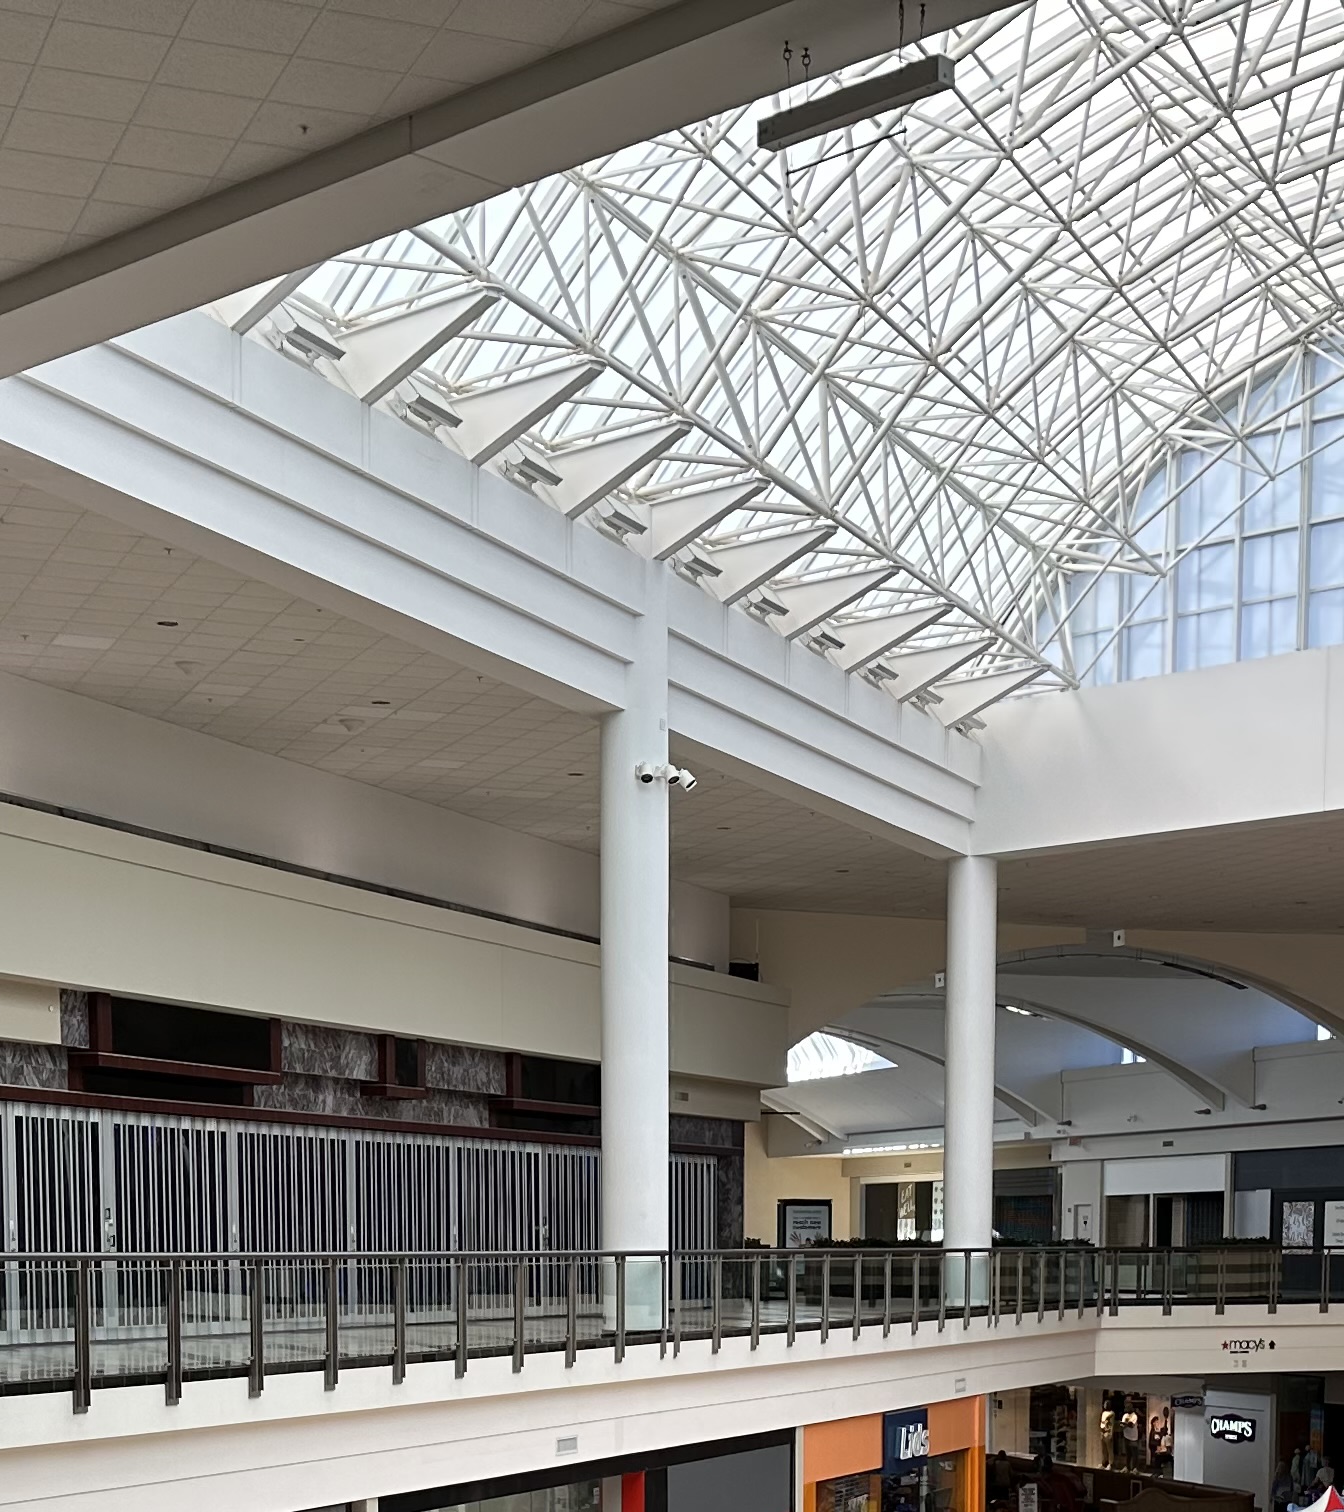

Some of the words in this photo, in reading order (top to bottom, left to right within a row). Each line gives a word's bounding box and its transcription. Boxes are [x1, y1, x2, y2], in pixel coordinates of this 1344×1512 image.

[1229, 1338, 1266, 1353] macy's
[1211, 1418, 1253, 1438] CHAMPS
[899, 1423, 930, 1461] Lids
